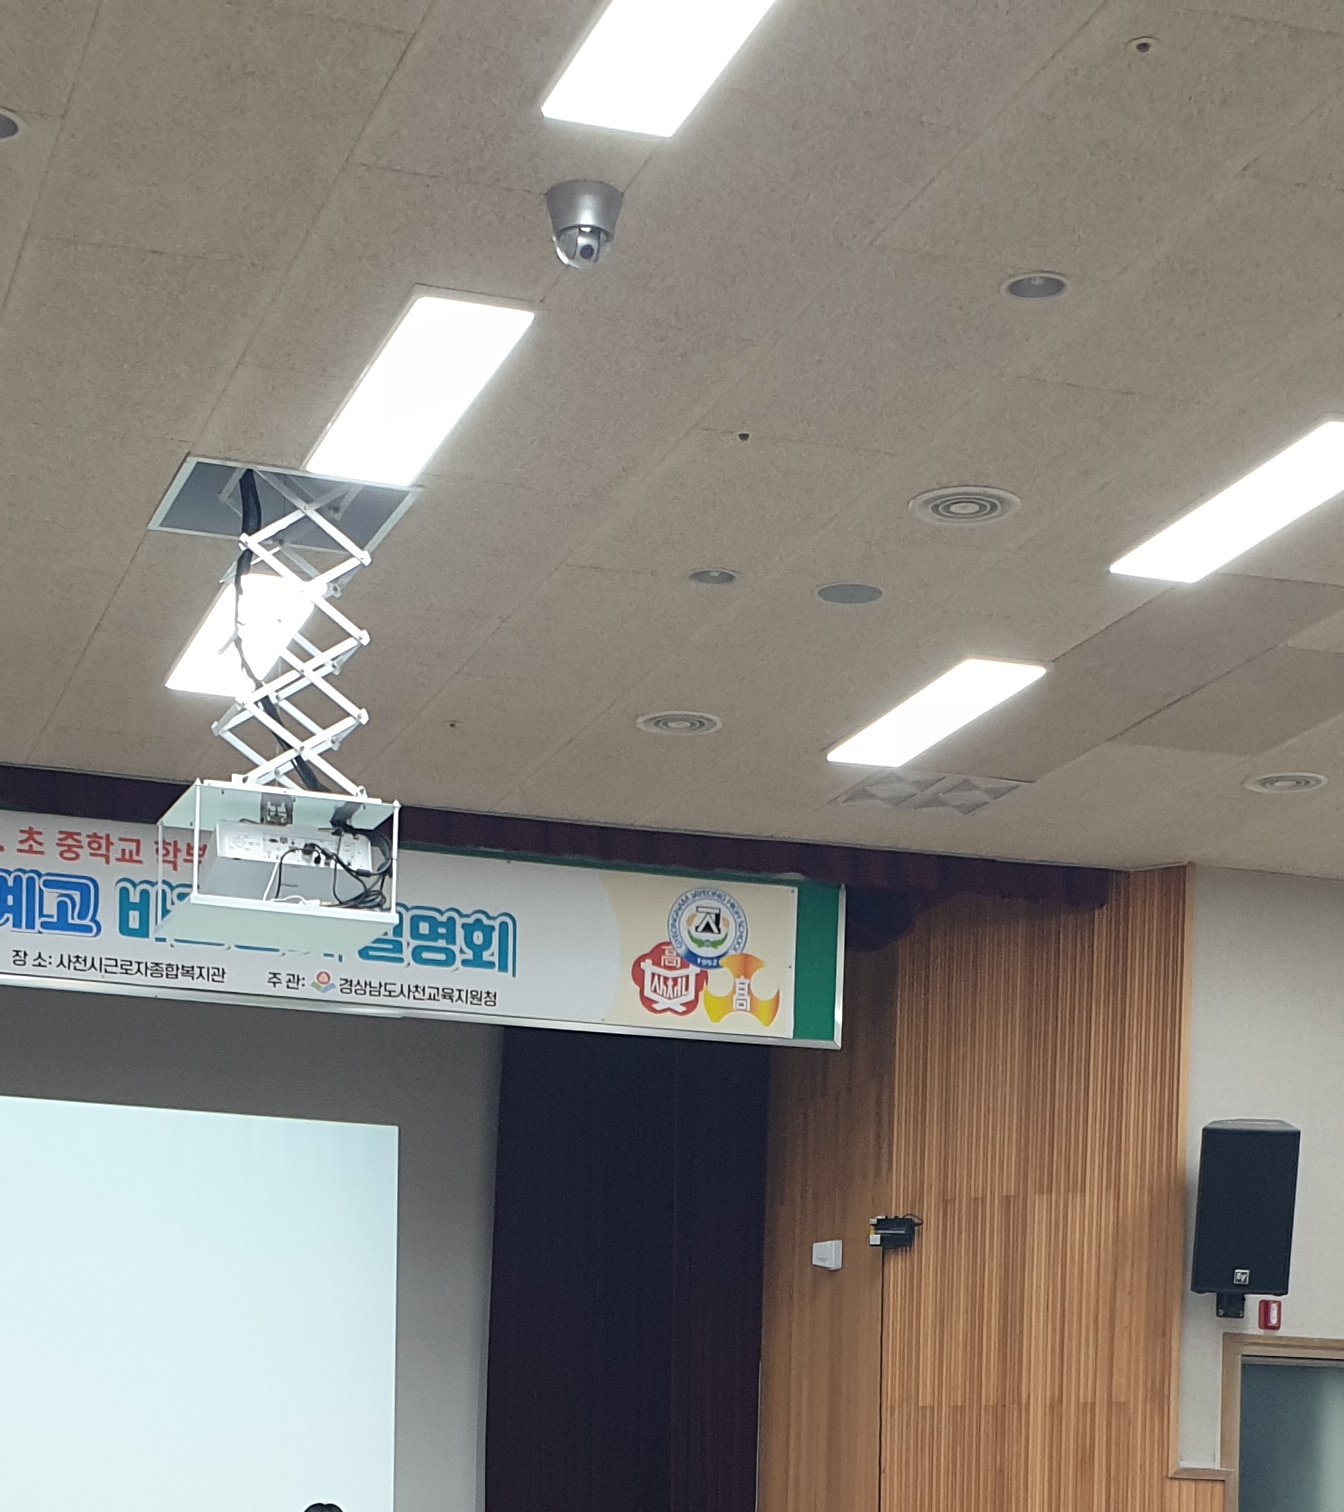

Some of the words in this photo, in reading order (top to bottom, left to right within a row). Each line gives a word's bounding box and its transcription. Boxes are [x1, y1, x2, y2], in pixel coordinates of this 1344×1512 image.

[16, 826, 45, 855] 초
[56, 830, 144, 865] 중학교
[56, 953, 227, 984] 사천시근로자종합복지관
[697, 957, 718, 967] 1952
[339, 977, 498, 1007] 경상남도사천교육지원청
